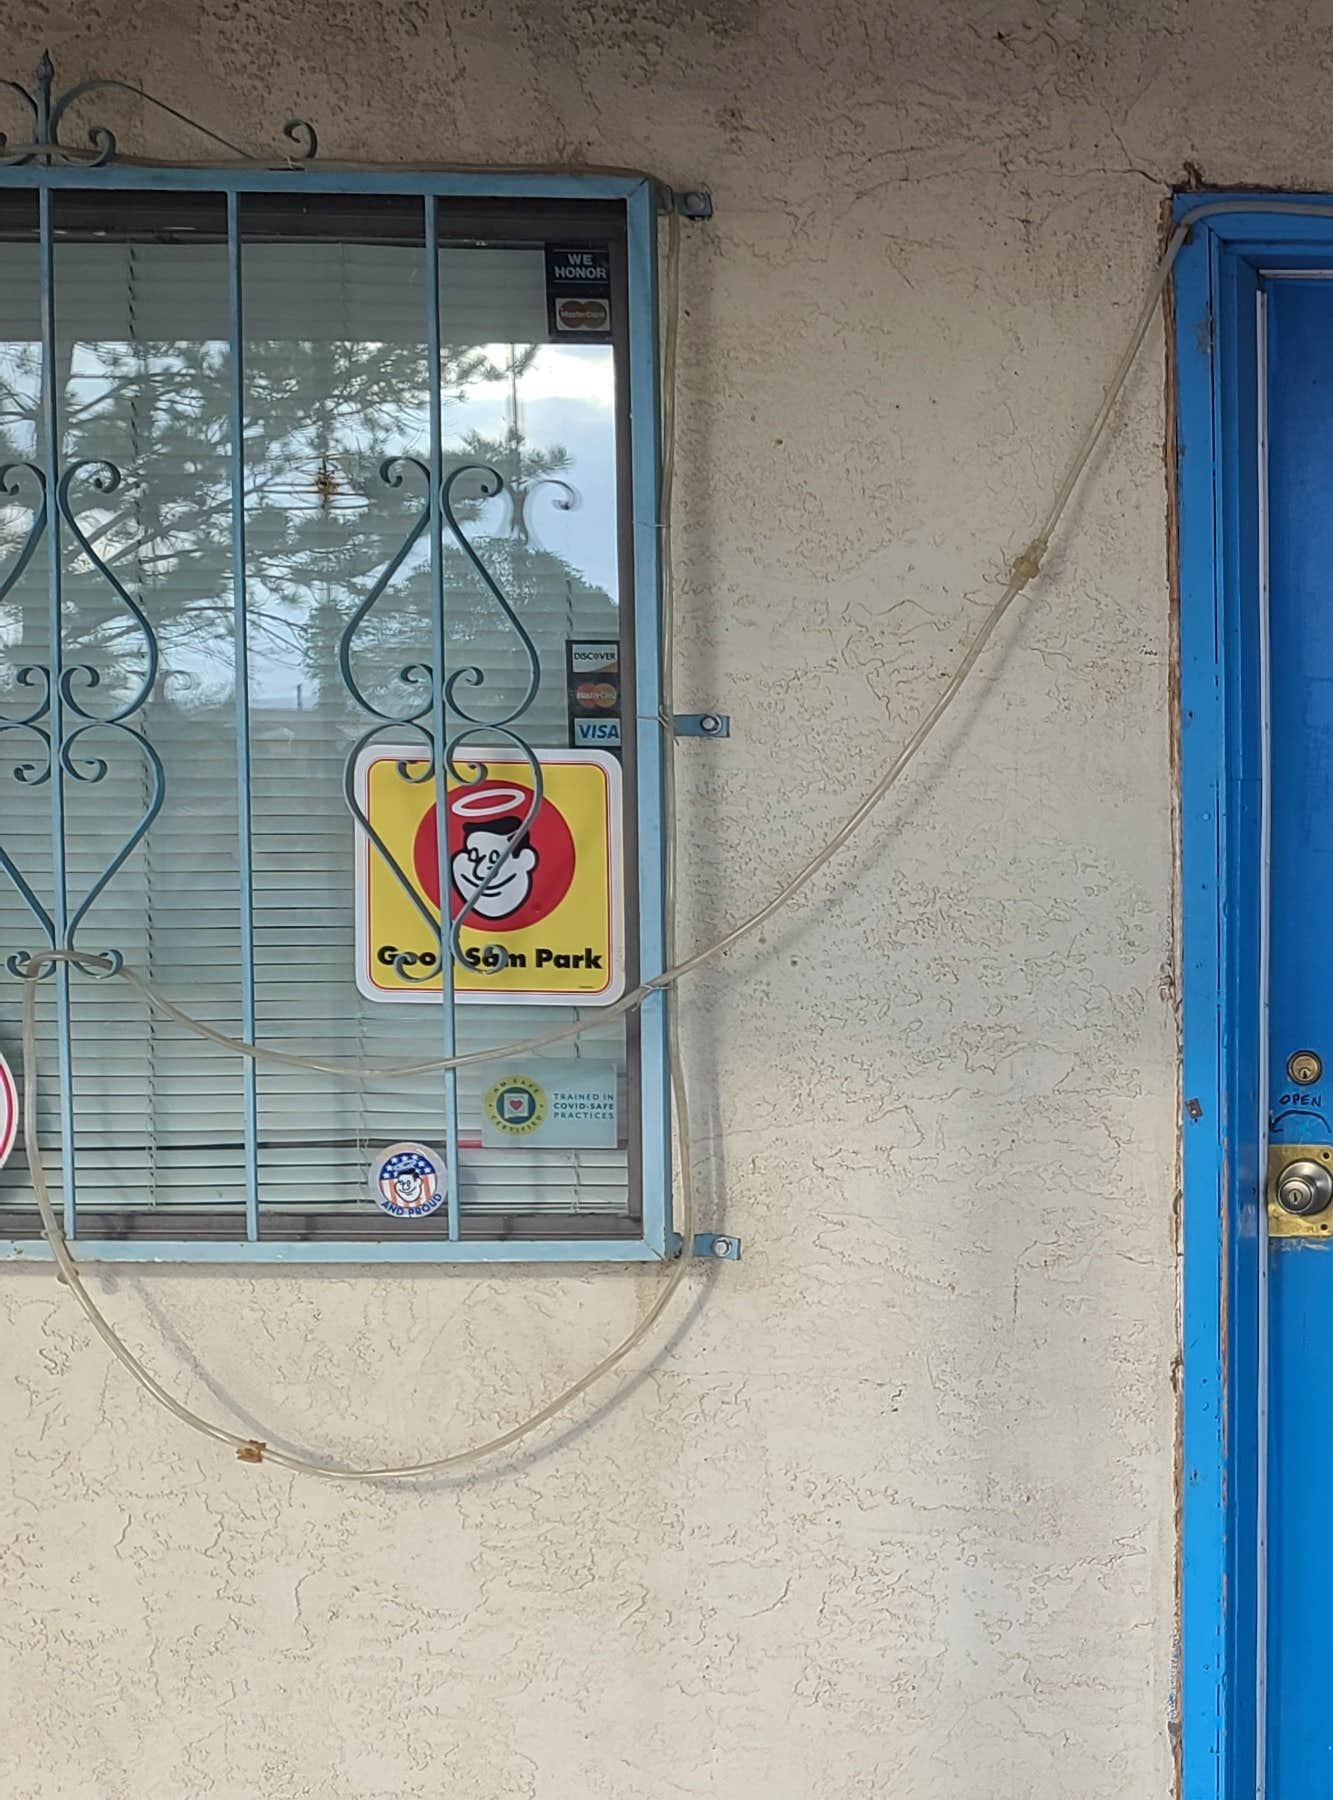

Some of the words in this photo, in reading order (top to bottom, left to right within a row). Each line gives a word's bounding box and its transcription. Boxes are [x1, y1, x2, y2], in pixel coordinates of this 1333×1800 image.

[567, 253, 593, 266] WE
[553, 265, 608, 279] HONOR
[574, 652, 616, 661] DISCOVER
[578, 724, 620, 739] VISA
[377, 945, 441, 967] Goo
[536, 948, 603, 969] Park
[553, 1093, 600, 1101] TRAINED
[603, 1093, 614, 1101] IN
[1280, 1094, 1322, 1107] OPEN
[553, 1102, 615, 1111] COVID-SAFE
[553, 1111, 615, 1120] PRACTICES
[381, 1200, 404, 1216] AND
[408, 1193, 442, 1216] PROUD
